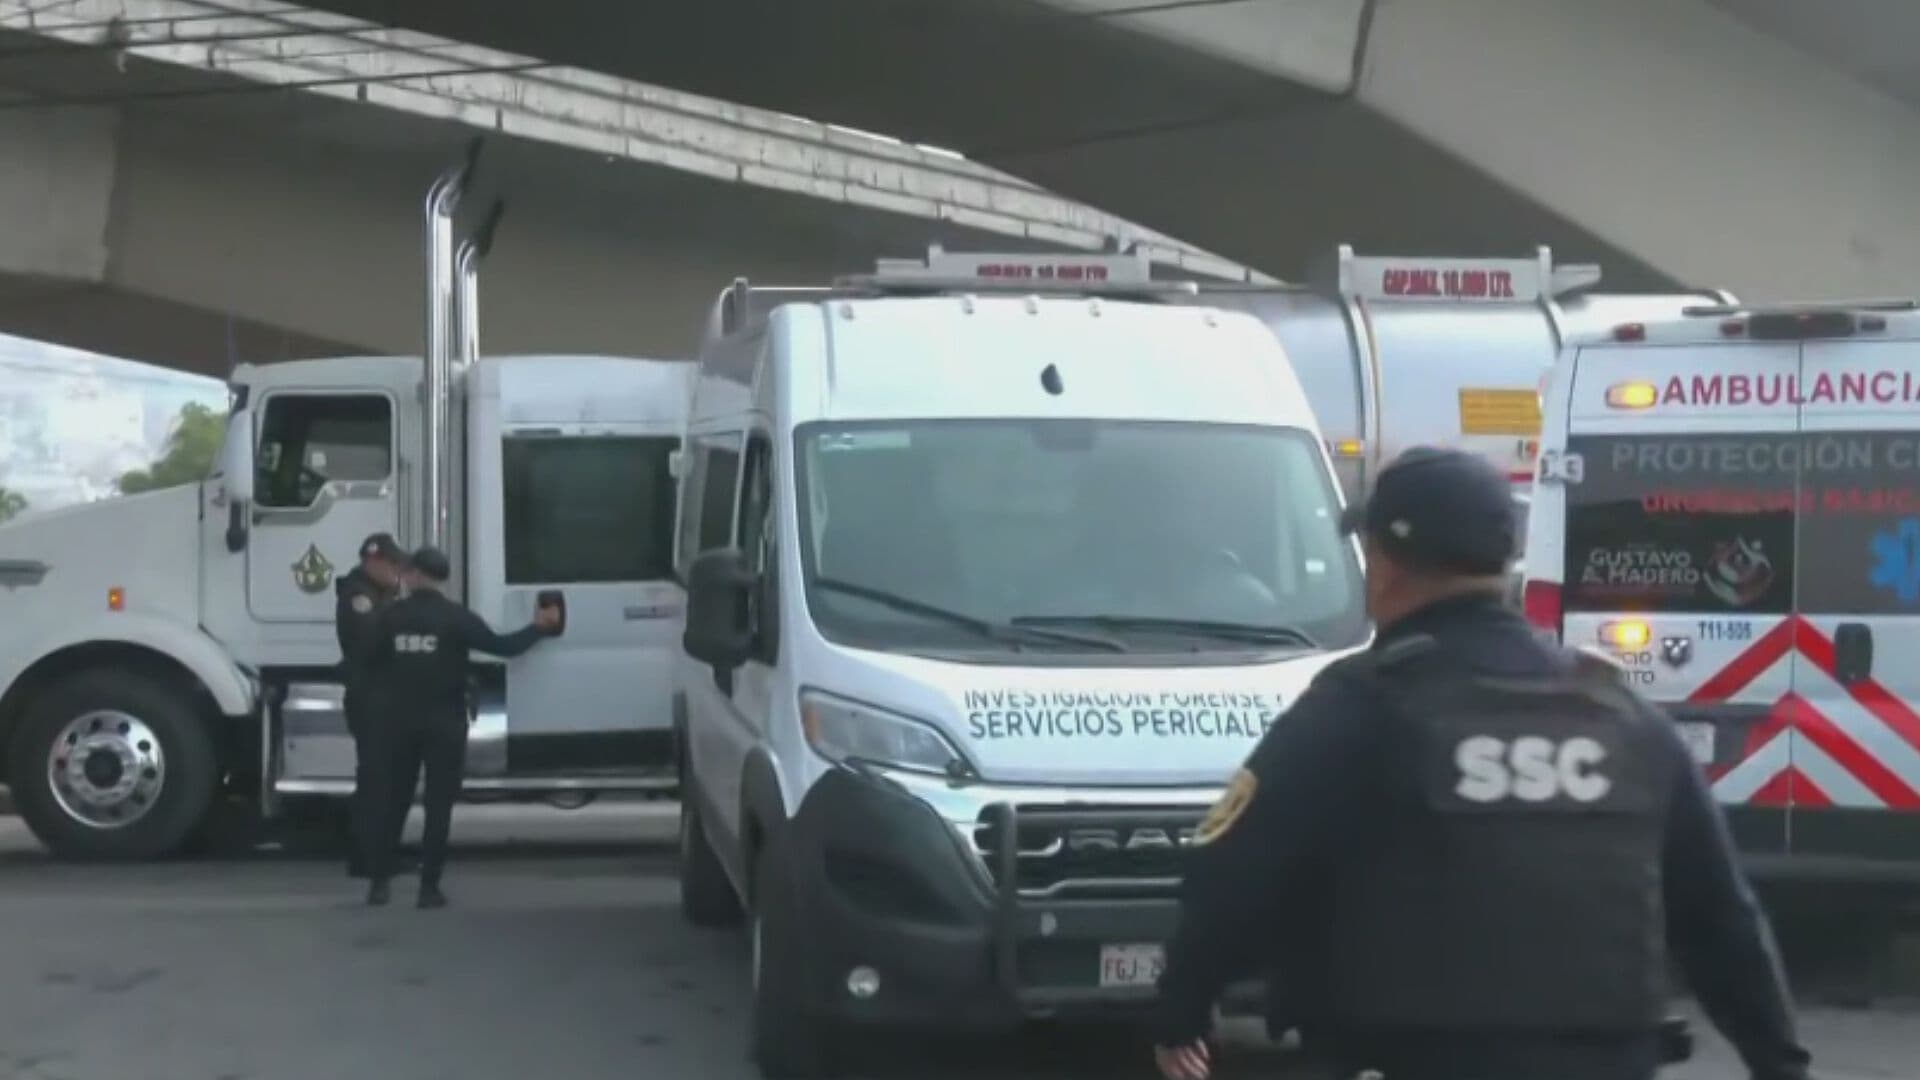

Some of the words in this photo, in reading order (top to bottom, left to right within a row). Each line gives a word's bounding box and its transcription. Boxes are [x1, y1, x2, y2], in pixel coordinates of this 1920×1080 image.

[1662, 371, 1920, 406] AMBULANCI
[1589, 549, 1691, 567] GUSTAVO
[969, 709, 1124, 738] SERVICIOS
[1132, 709, 1274, 737] PERICIALE
[1455, 735, 1612, 802] SSC
